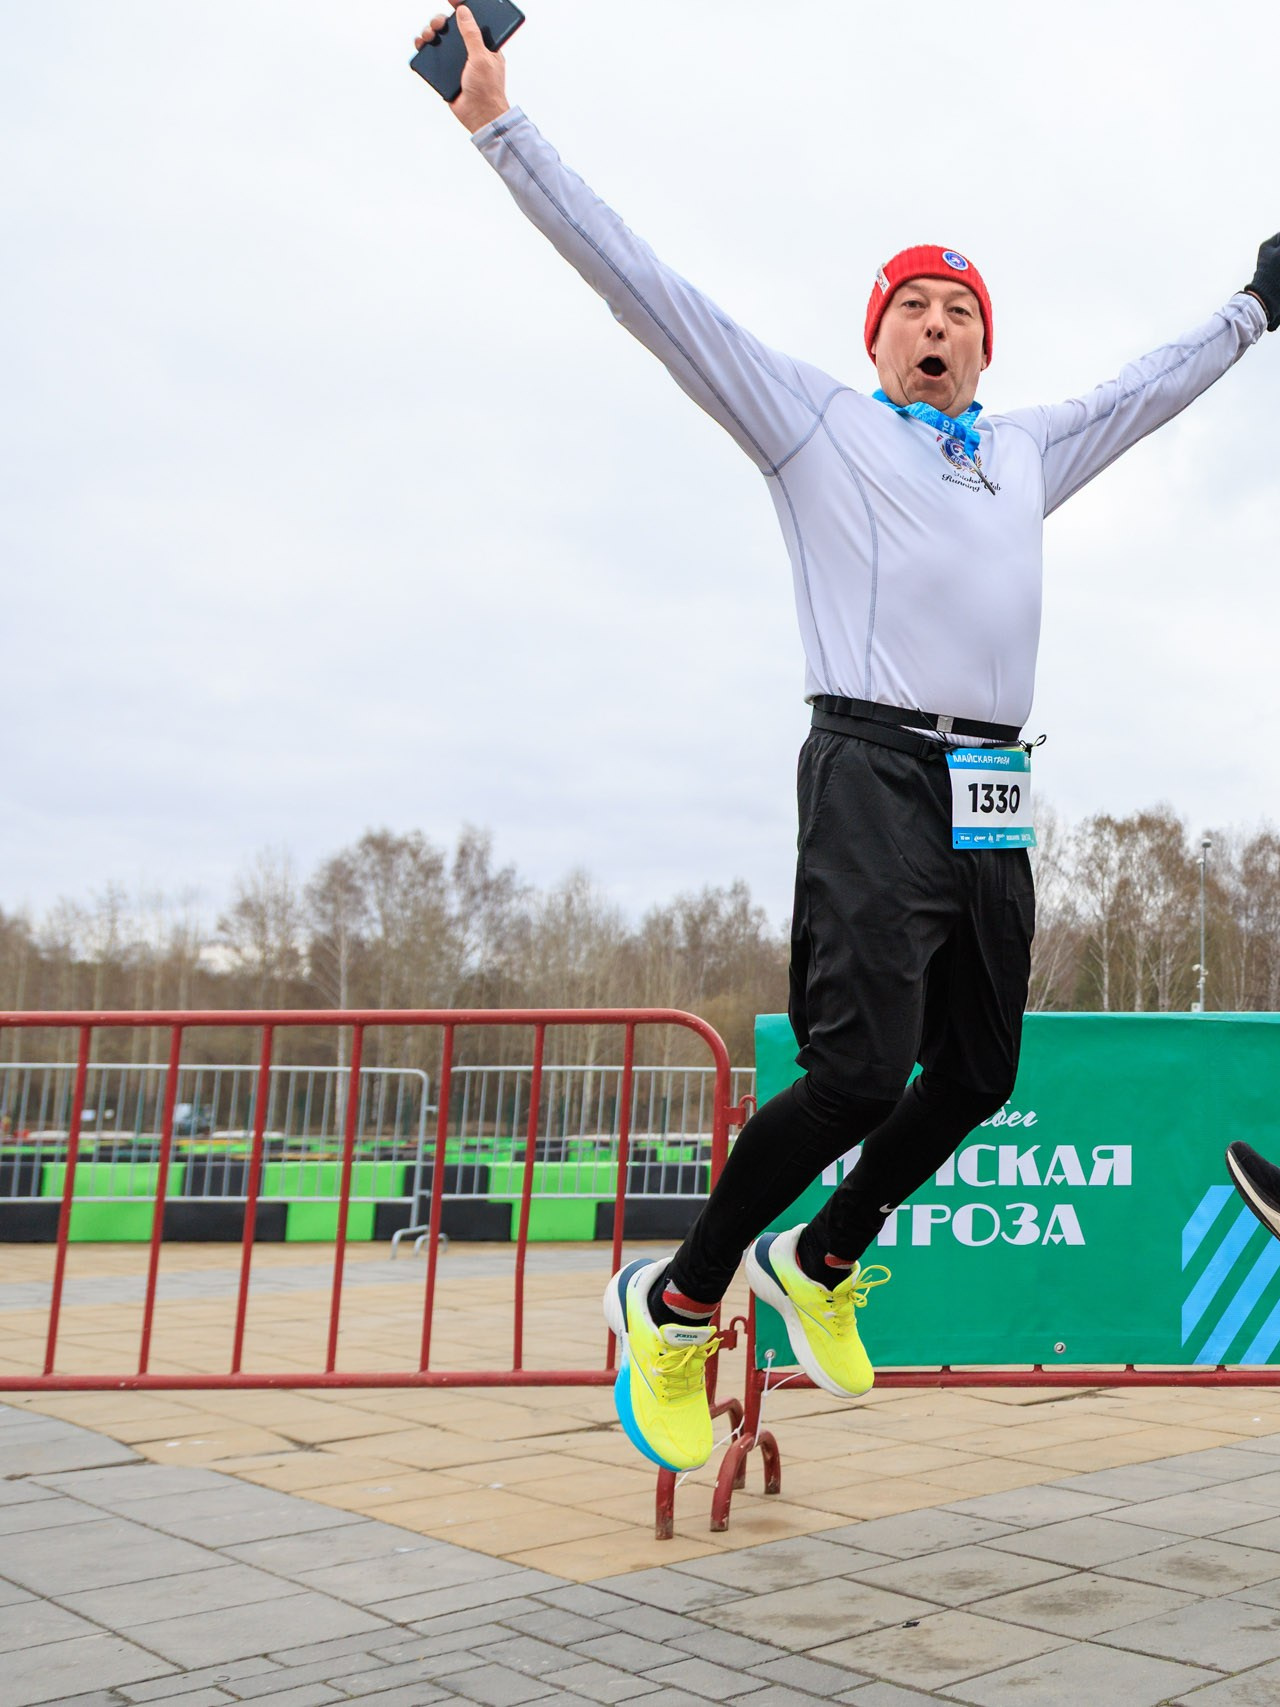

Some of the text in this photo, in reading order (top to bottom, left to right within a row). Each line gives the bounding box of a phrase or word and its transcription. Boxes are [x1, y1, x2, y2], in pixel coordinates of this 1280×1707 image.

[941, 473, 980, 492] Running
[952, 753, 993, 764] МАЙСКАЯ
[968, 783, 1021, 814] 1330
[877, 1203, 1086, 1246] ГРОЗА
